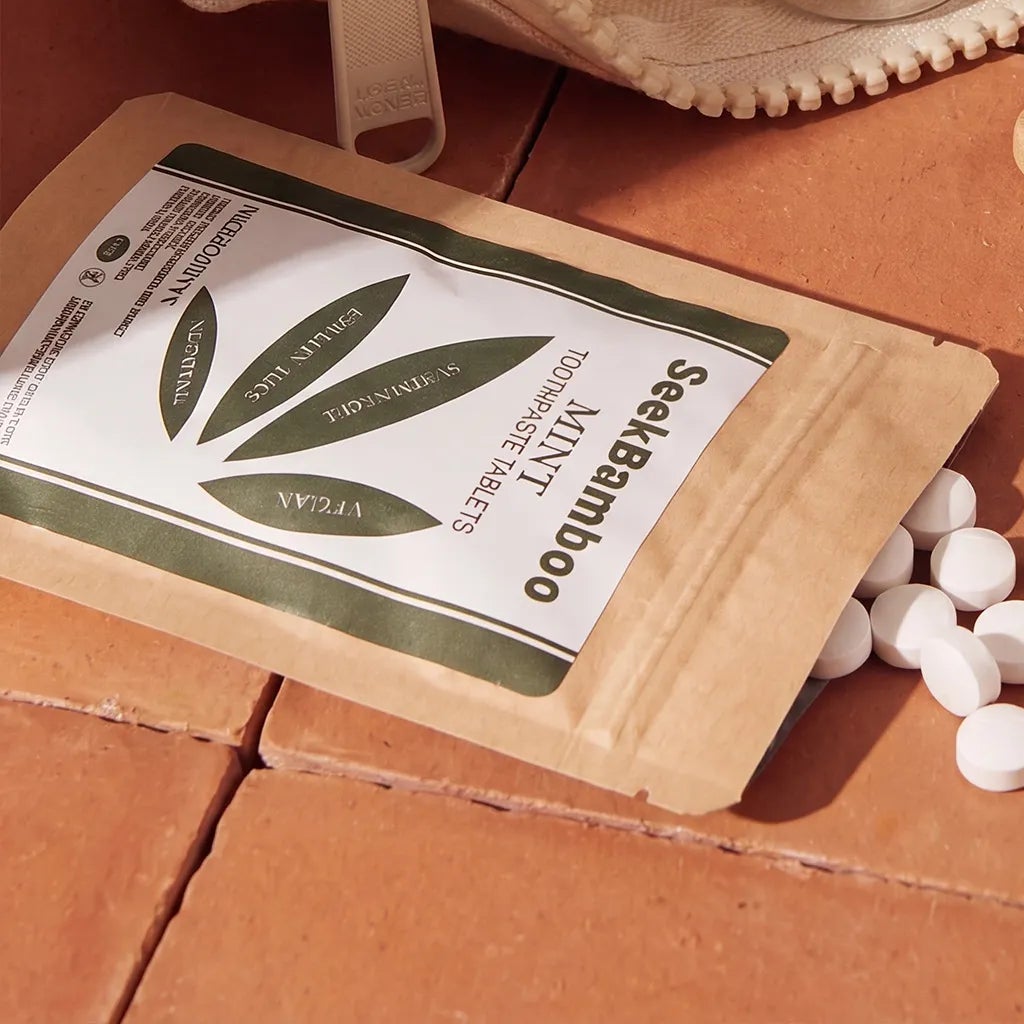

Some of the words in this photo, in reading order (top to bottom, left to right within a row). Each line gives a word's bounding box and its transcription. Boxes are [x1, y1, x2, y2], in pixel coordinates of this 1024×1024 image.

[500, 348, 590, 456] TOOTHPASTE
[515, 398, 601, 497] MINT
[451, 457, 517, 535] TABLETS
[523, 358, 709, 604] SeekBamboo
